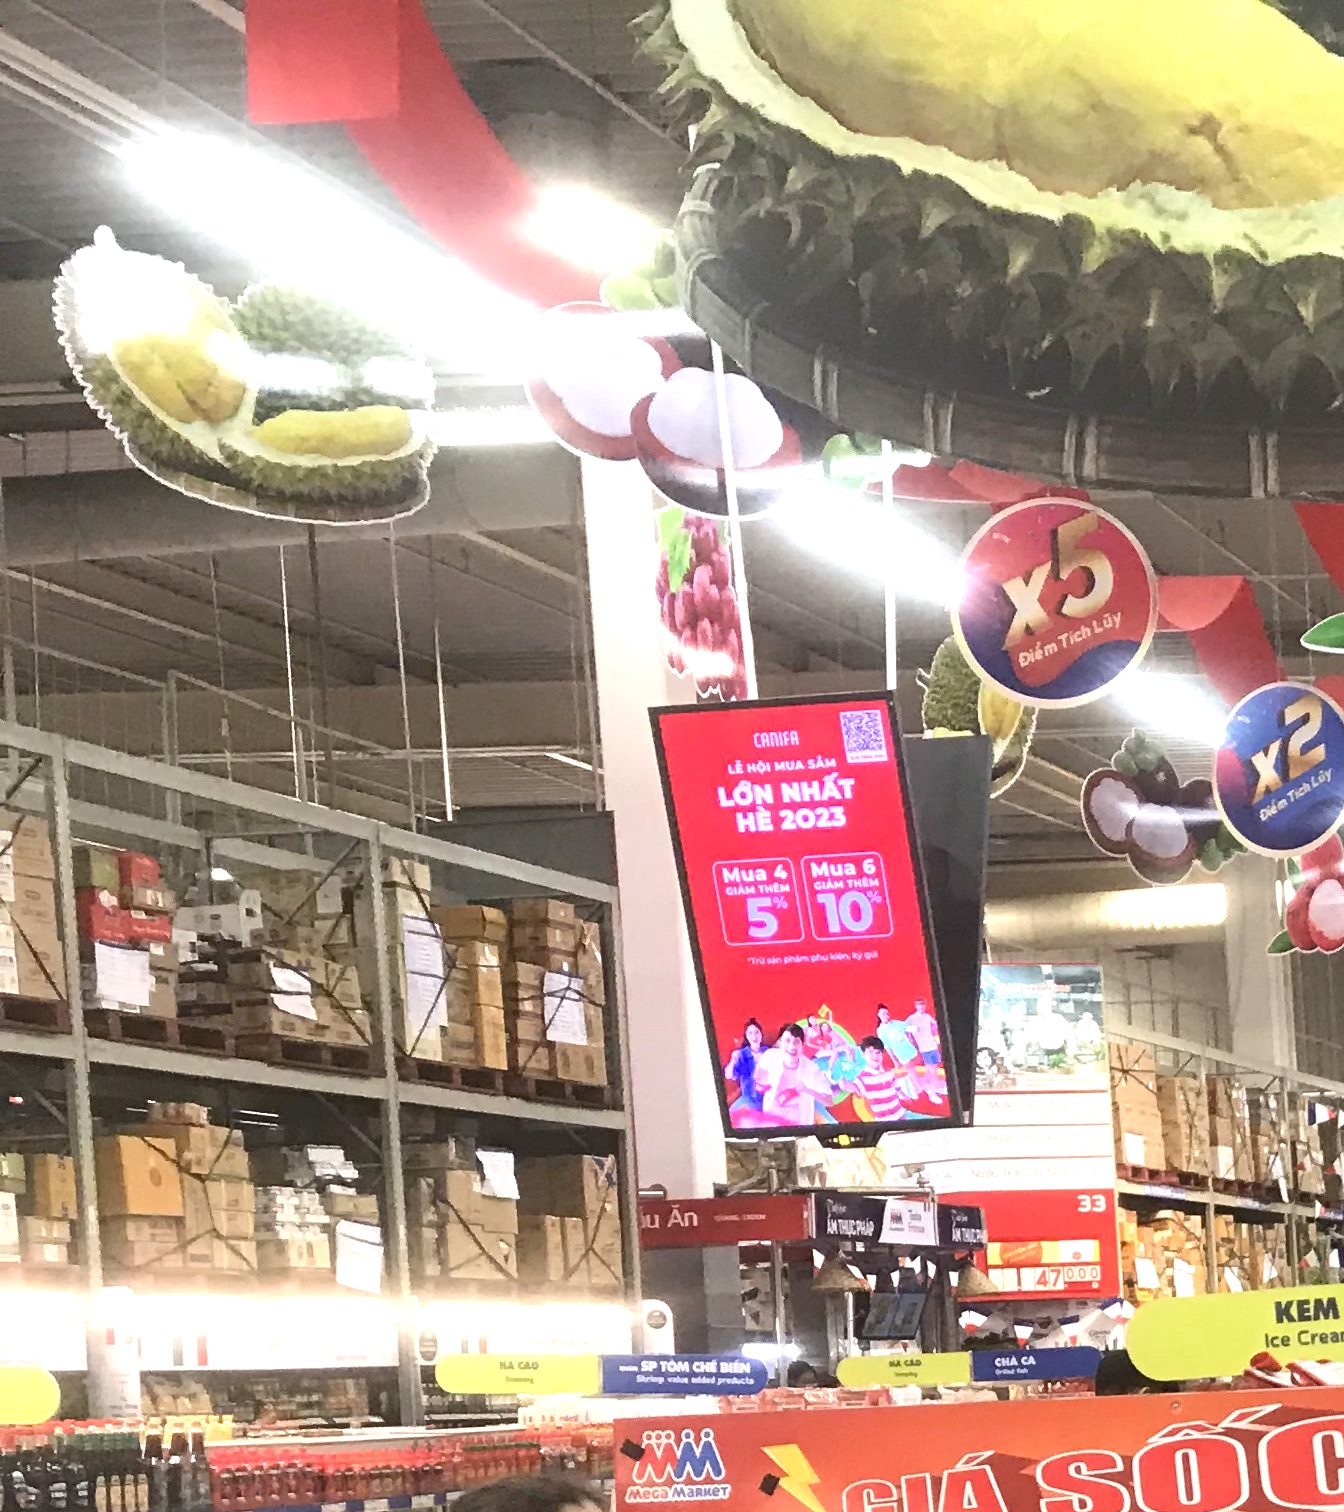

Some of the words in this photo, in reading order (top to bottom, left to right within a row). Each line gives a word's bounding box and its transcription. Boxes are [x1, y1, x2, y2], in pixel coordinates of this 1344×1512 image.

[1002, 511, 1114, 650] x5
[1058, 626, 1092, 657] Tích
[753, 730, 800, 748] CANIFA
[1252, 694, 1327, 806] x2
[774, 760, 805, 773] MUA
[778, 806, 847, 830] 2023
[722, 867, 768, 883] Mua
[774, 864, 788, 880] 4
[810, 861, 857, 878] Mua
[862, 859, 877, 875] 6
[1077, 1194, 1107, 1213] 33
[1274, 1296, 1341, 1324] KEM
[1264, 1331, 1292, 1349] Ice
